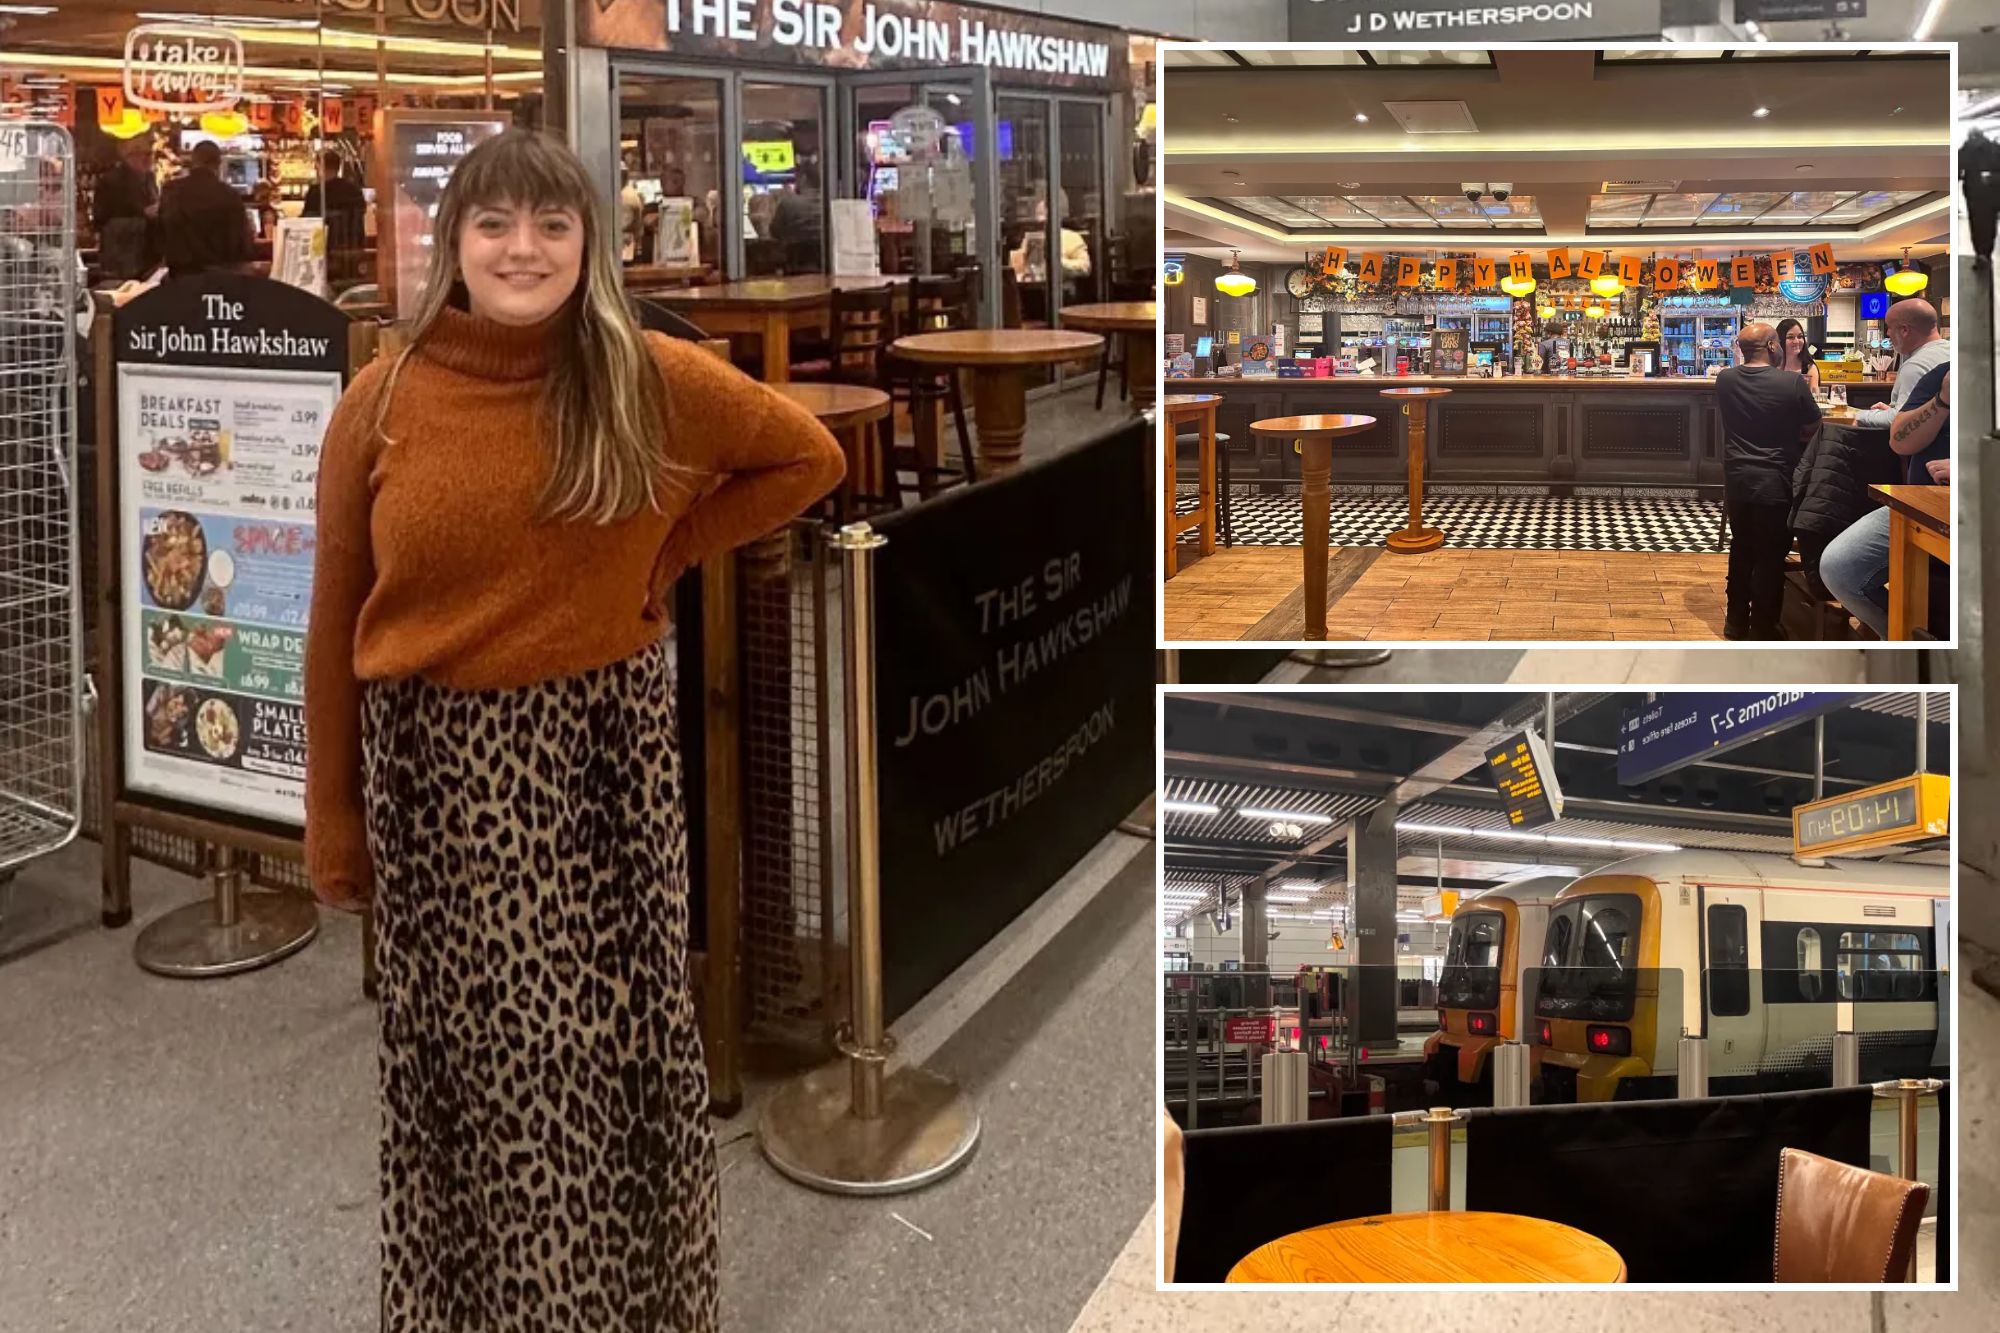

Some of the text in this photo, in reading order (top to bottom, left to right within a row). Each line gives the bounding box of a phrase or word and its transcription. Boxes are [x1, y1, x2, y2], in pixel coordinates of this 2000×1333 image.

[1347, 1, 1593, 33] J D WETHERSPOON
[154, 38, 219, 64] take
[668, 0, 1109, 77] THE SIR JOHN HAWKSHAW
[152, 71, 216, 102] away
[1328, 251, 1829, 282] HAPPY HALLOWEEN
[202, 294, 244, 321] The
[130, 325, 329, 358] Sir John Hawkshaw
[141, 395, 221, 414] BREAKFAST
[141, 412, 184, 429] DEALS
[974, 551, 1082, 633] THE SIR
[237, 629, 303, 653] WRAP DE
[894, 574, 1132, 747] JOHN HAWKSHAW
[256, 702, 305, 724] SMALL
[934, 699, 1115, 856] WETHERSPOON
